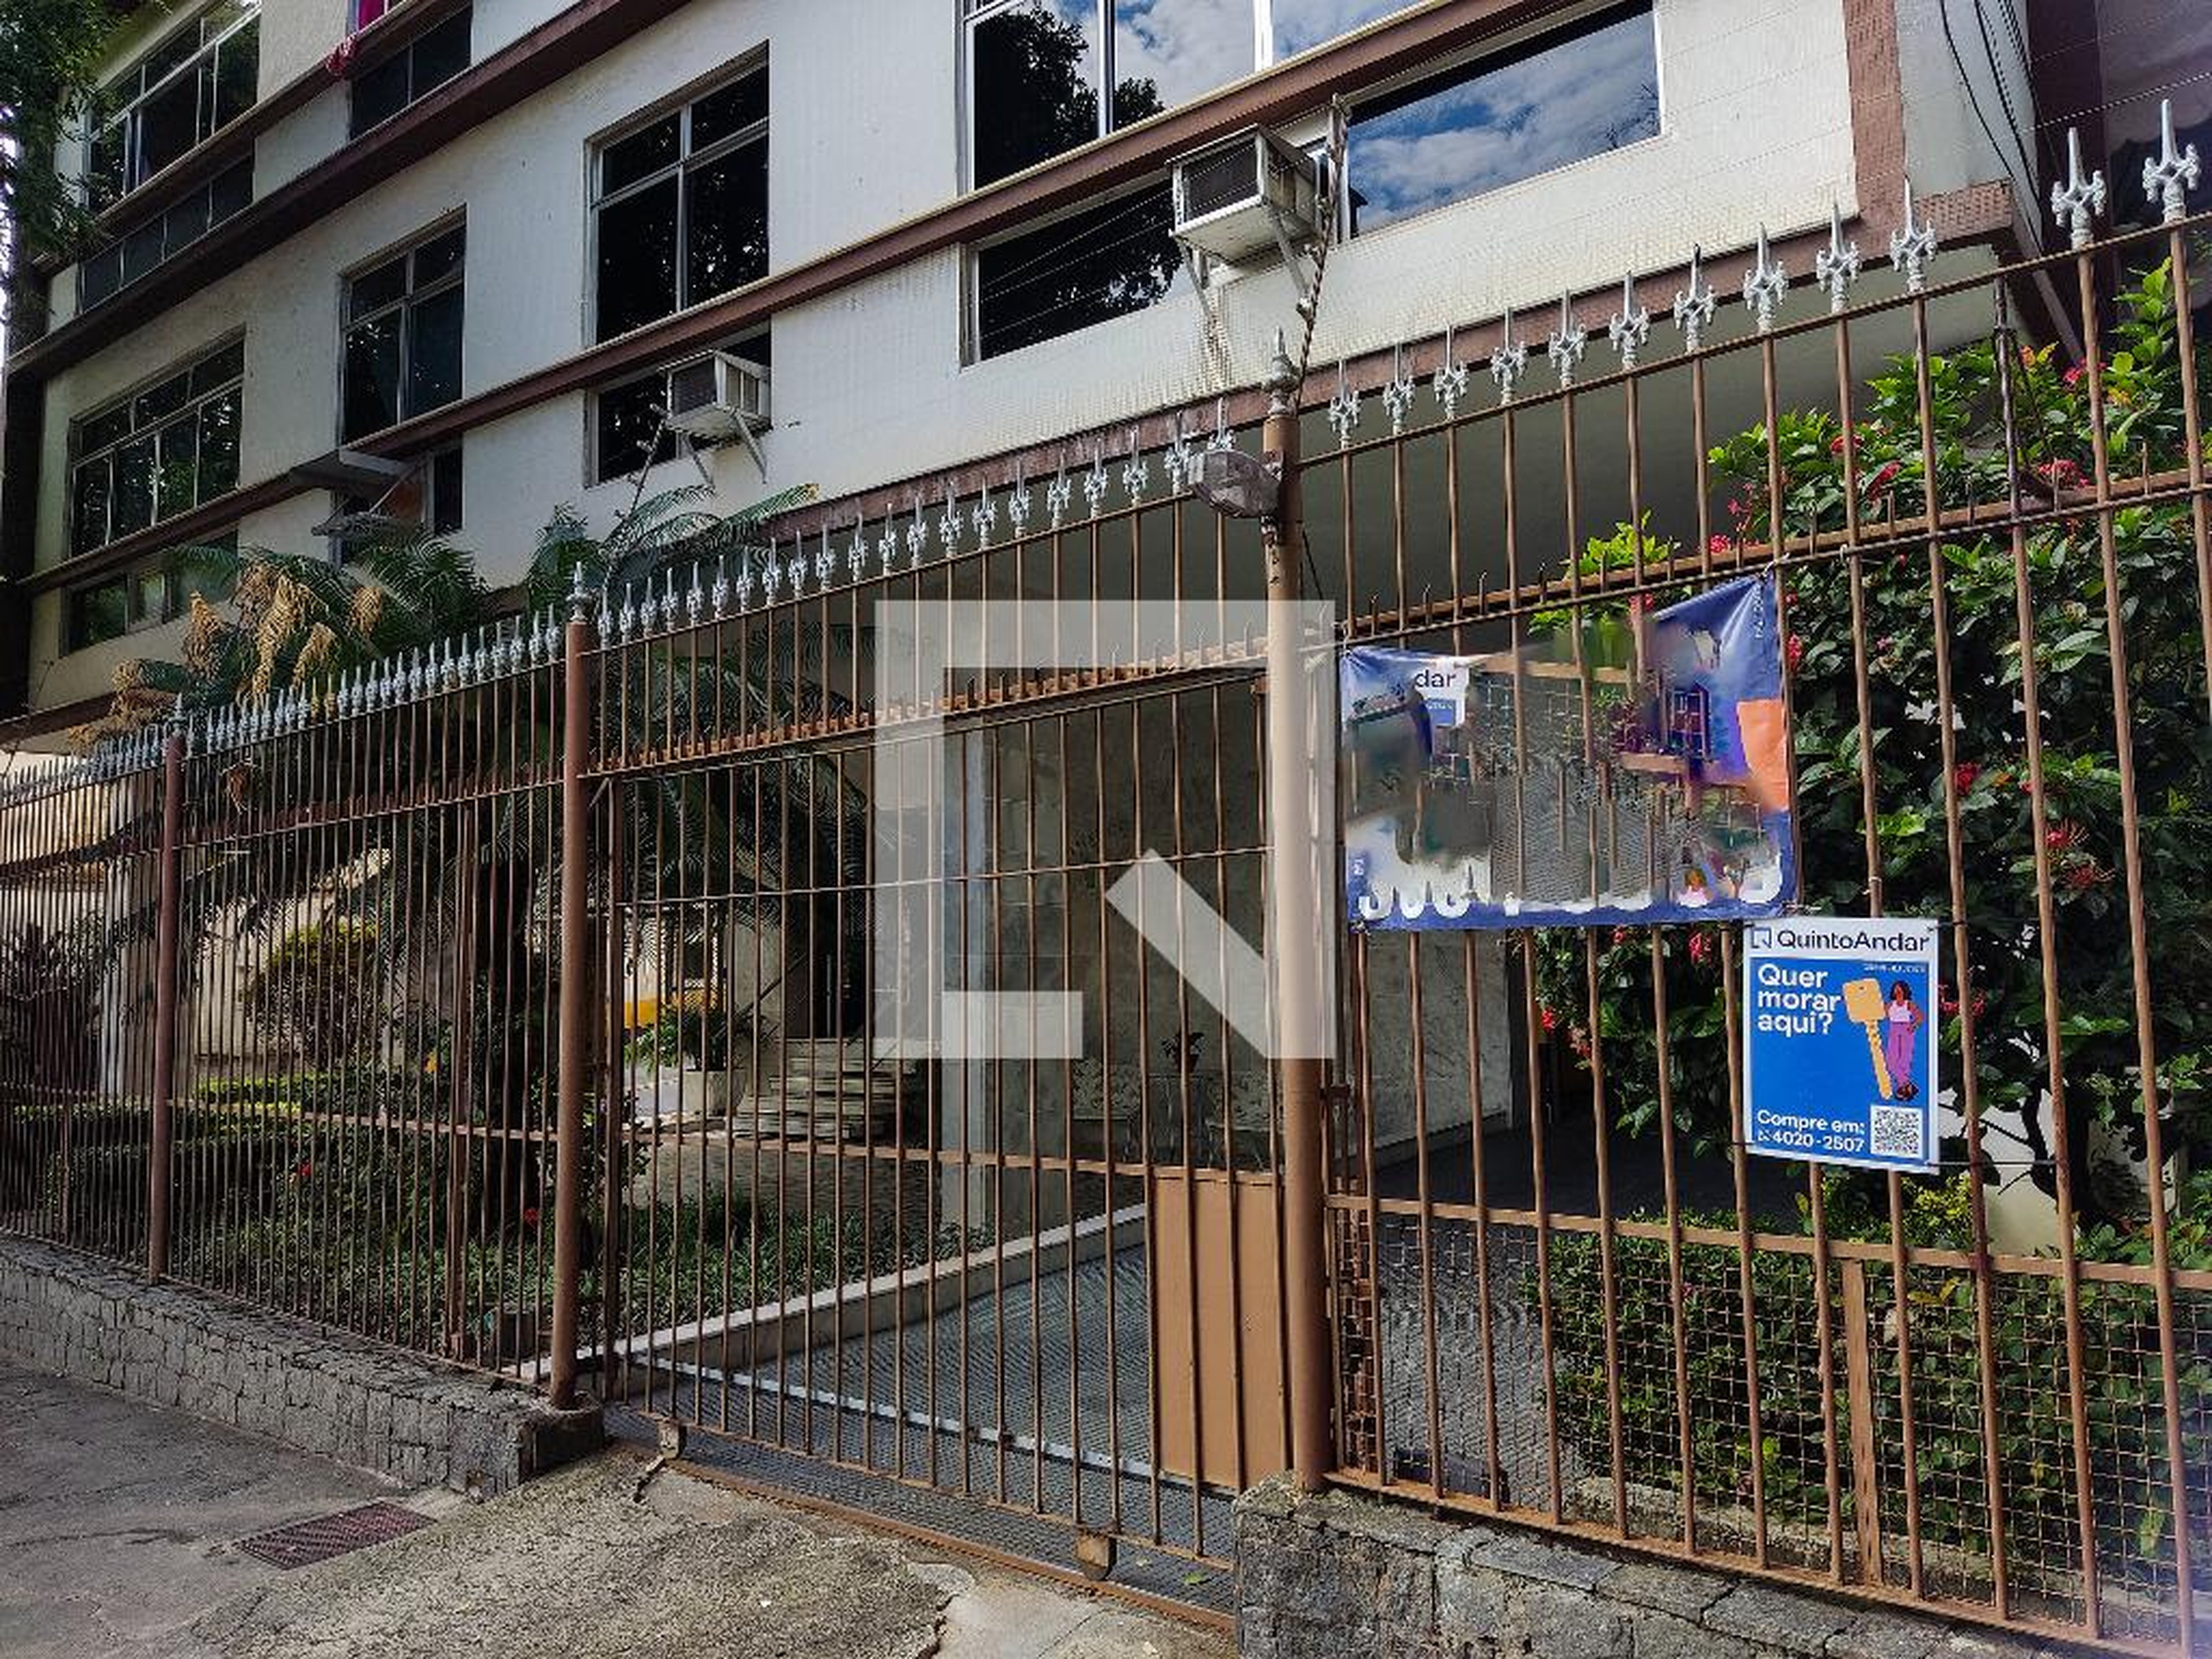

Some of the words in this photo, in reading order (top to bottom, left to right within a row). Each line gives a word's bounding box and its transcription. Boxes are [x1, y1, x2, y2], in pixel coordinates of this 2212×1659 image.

[1777, 930, 1929, 952] QuintoAndar
[1758, 963, 1828, 988] Quer
[1758, 991, 1842, 1012] morar
[1758, 1011, 1833, 1037] aqui?
[1758, 1109, 1828, 1131] Compre
[1831, 1120, 1865, 1135] em:
